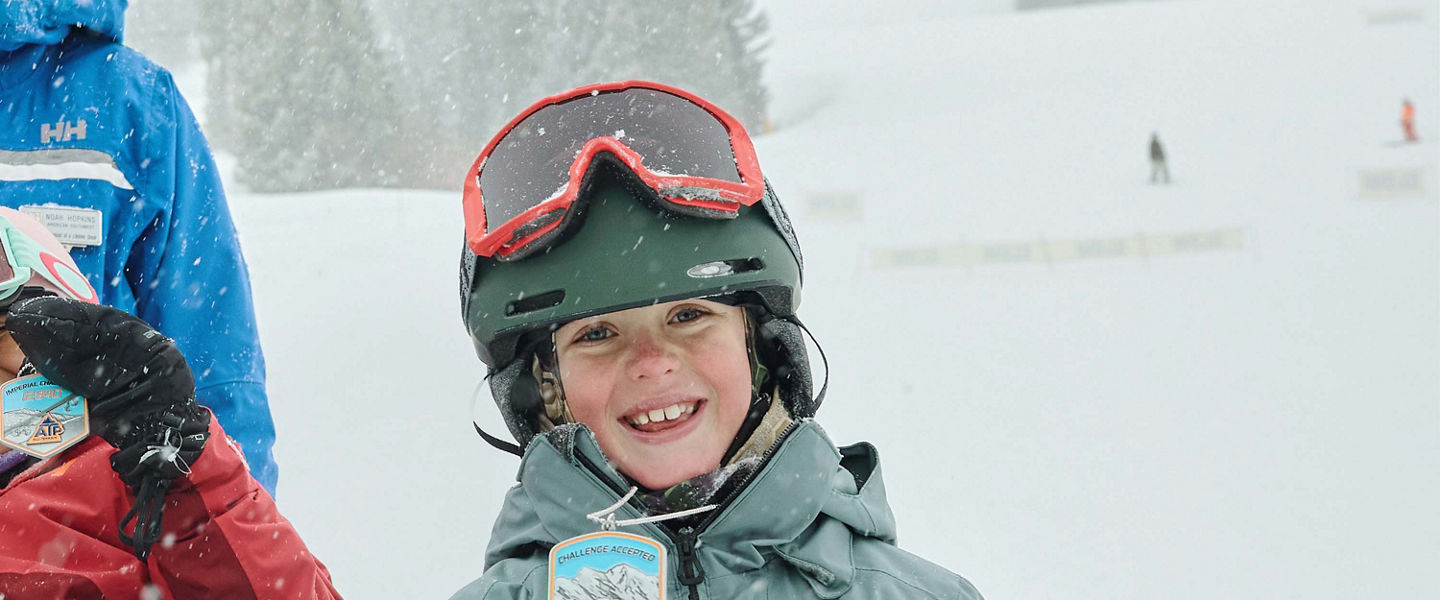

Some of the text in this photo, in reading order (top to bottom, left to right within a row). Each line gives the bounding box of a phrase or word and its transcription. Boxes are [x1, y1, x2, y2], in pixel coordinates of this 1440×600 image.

[41, 119, 86, 144] HH
[5, 381, 39, 396] IMPERIAL
[558, 545, 656, 565] CHALLENGE ACCEPTED
